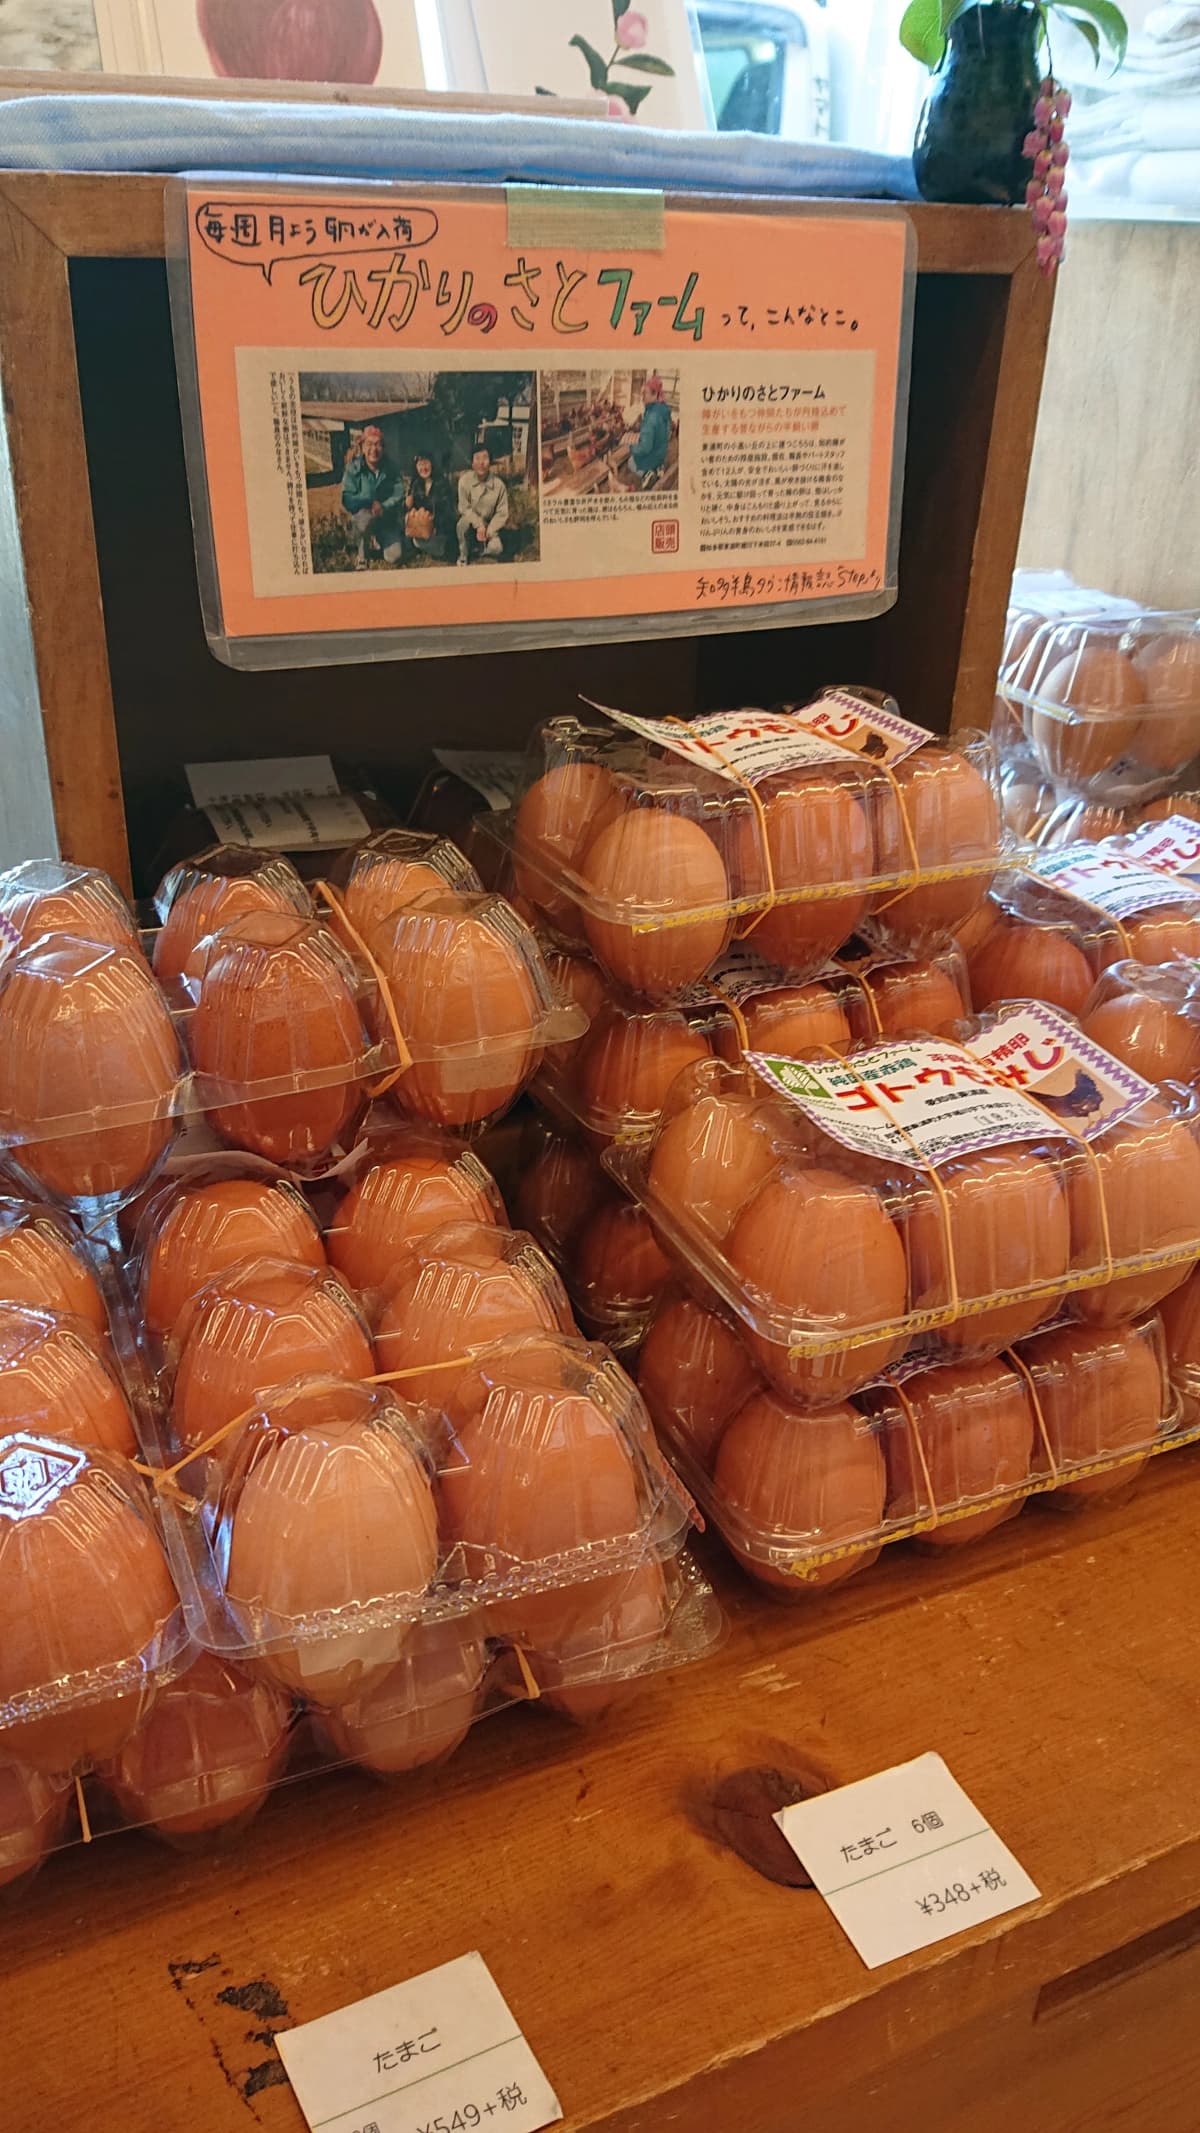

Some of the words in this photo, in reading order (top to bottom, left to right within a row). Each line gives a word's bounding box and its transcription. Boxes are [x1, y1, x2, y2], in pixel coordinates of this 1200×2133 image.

[702, 384, 826, 403] ひかりのさとファーム
[840, 1827, 897, 1863] たまご
[912, 1811, 944, 1833] 6個
[915, 1867, 1007, 1916] ¥348+税
[373, 2027, 441, 2073] たまご
